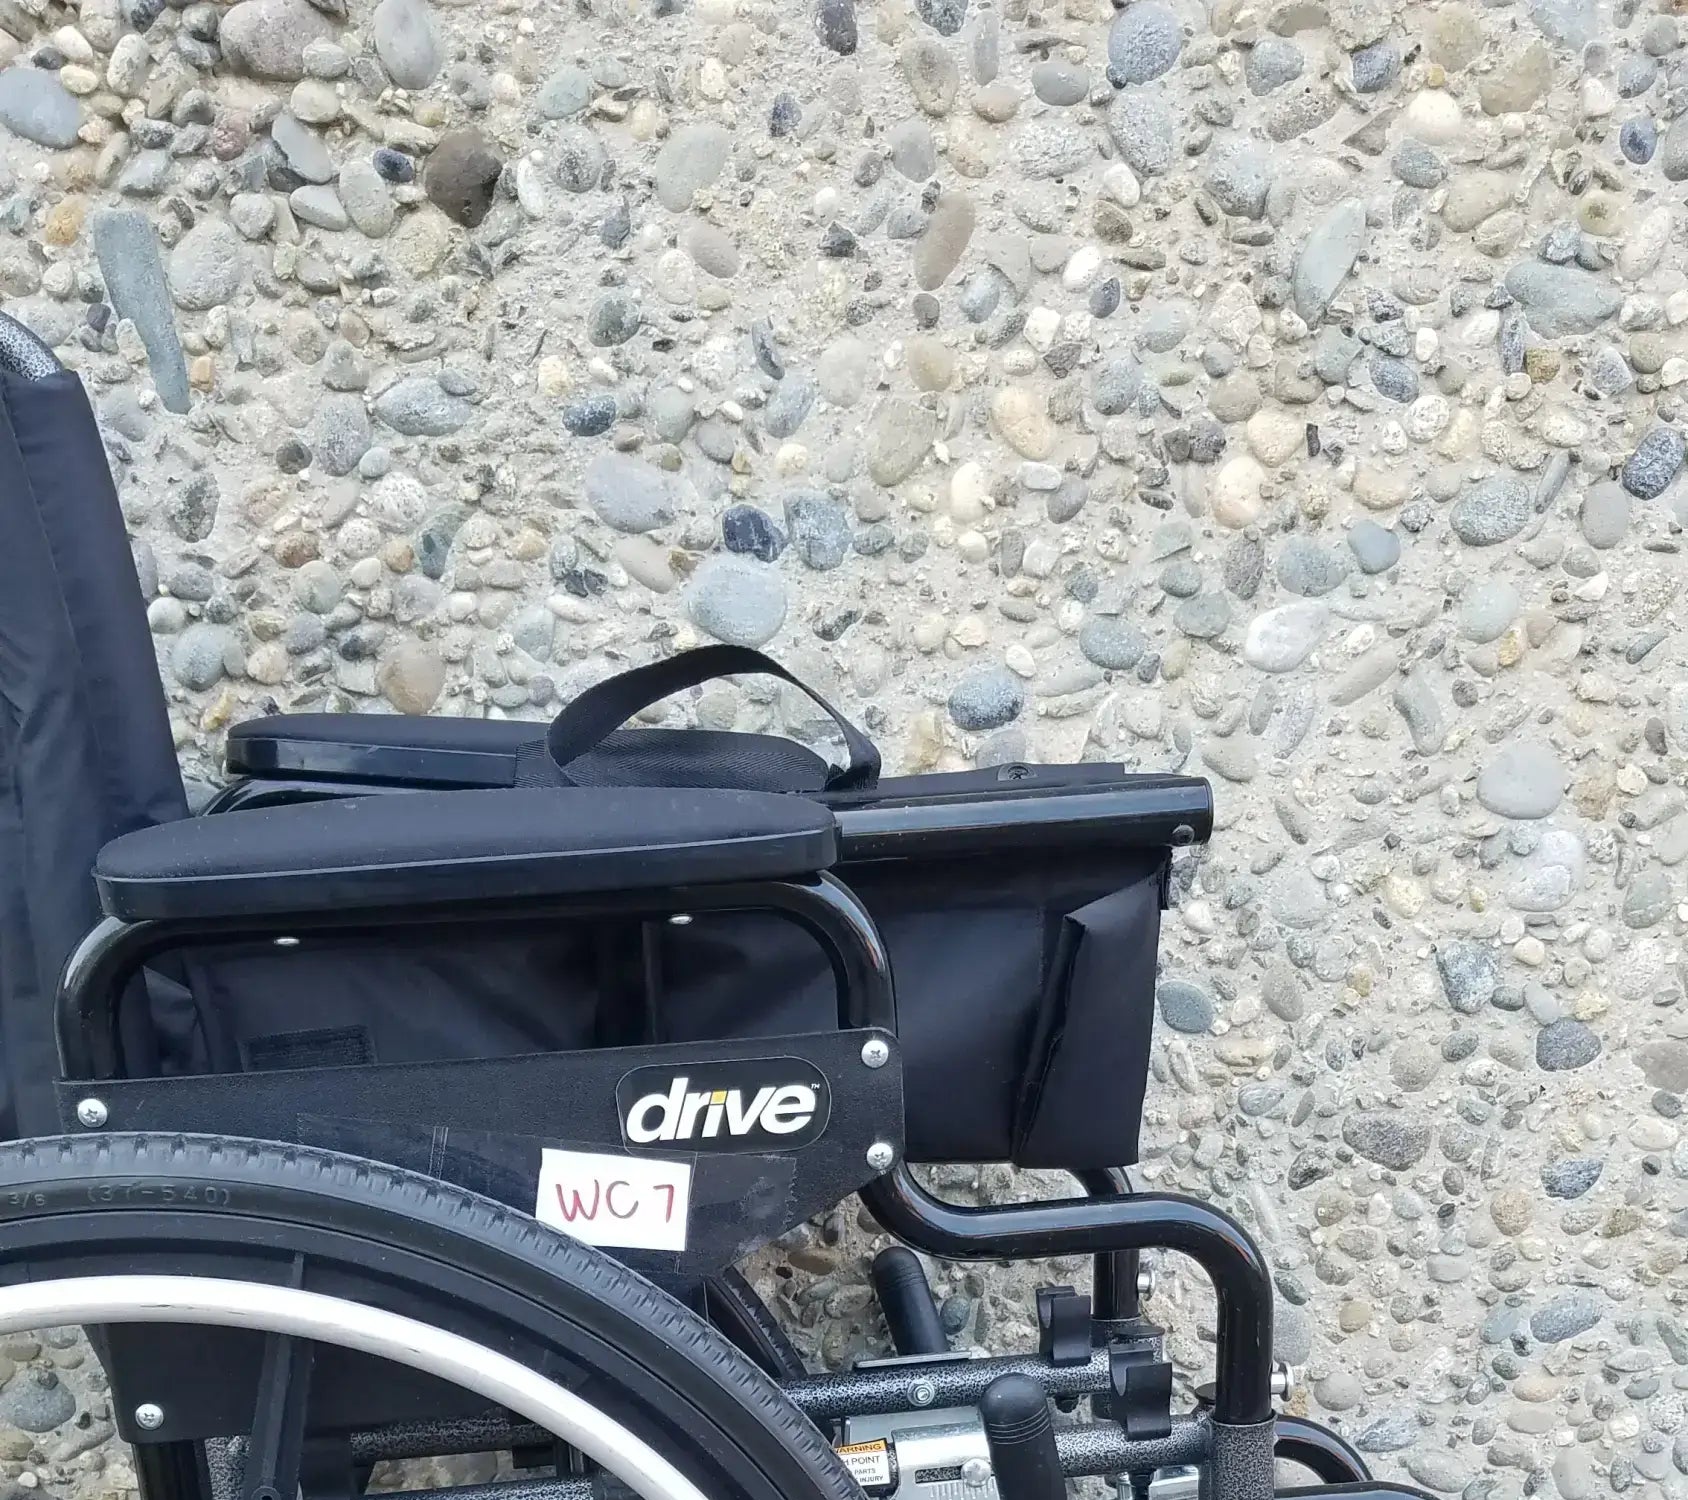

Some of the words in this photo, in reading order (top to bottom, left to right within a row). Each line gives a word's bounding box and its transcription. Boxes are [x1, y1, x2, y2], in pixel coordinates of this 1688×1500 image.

[626, 1077, 816, 1143] drive
[556, 1178, 639, 1223] WC
[653, 1184, 675, 1223] 7
[851, 1455, 879, 1465] POINT
